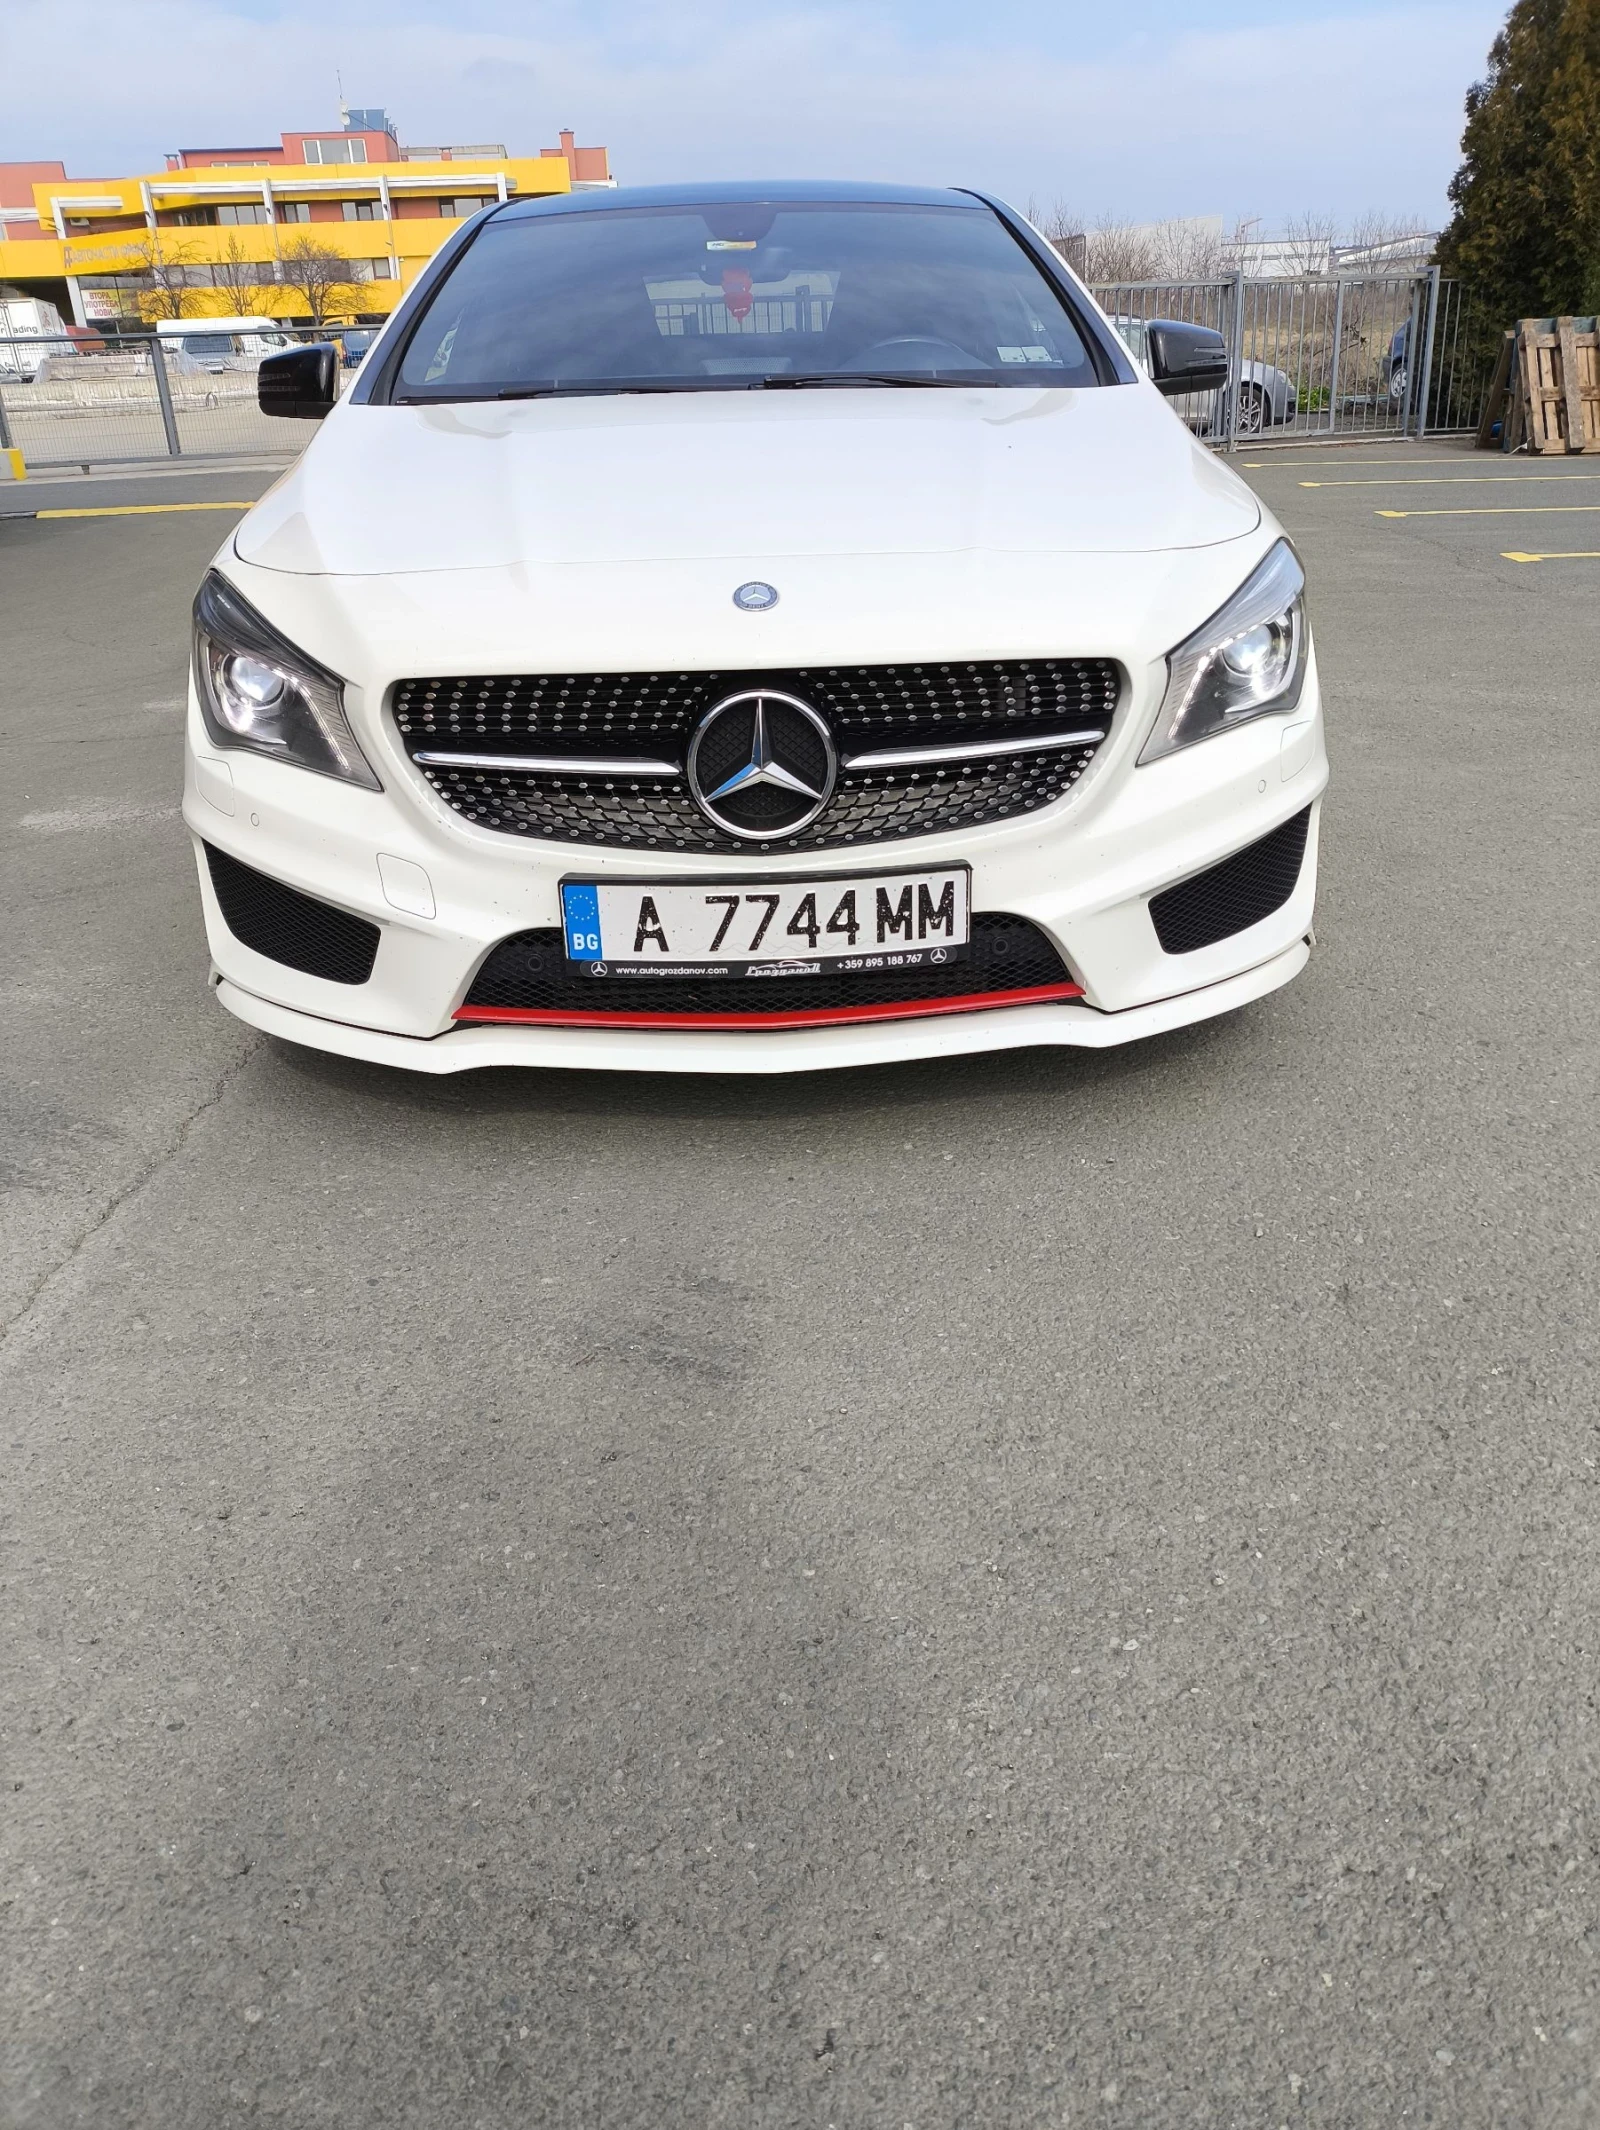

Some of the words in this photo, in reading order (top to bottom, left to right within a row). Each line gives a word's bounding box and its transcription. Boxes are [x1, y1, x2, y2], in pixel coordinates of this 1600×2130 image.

[85, 300, 119, 308] УПОТРЕБА
[572, 932, 599, 951] BG
[633, 895, 669, 952] A
[704, 889, 860, 952] 7744
[875, 880, 955, 943] MM
[837, 959, 863, 970] +359
[865, 957, 883, 967] 895
[887, 955, 904, 965] 188
[906, 954, 923, 964] 767
[615, 966, 729, 976] www.autogrozdanov.com
